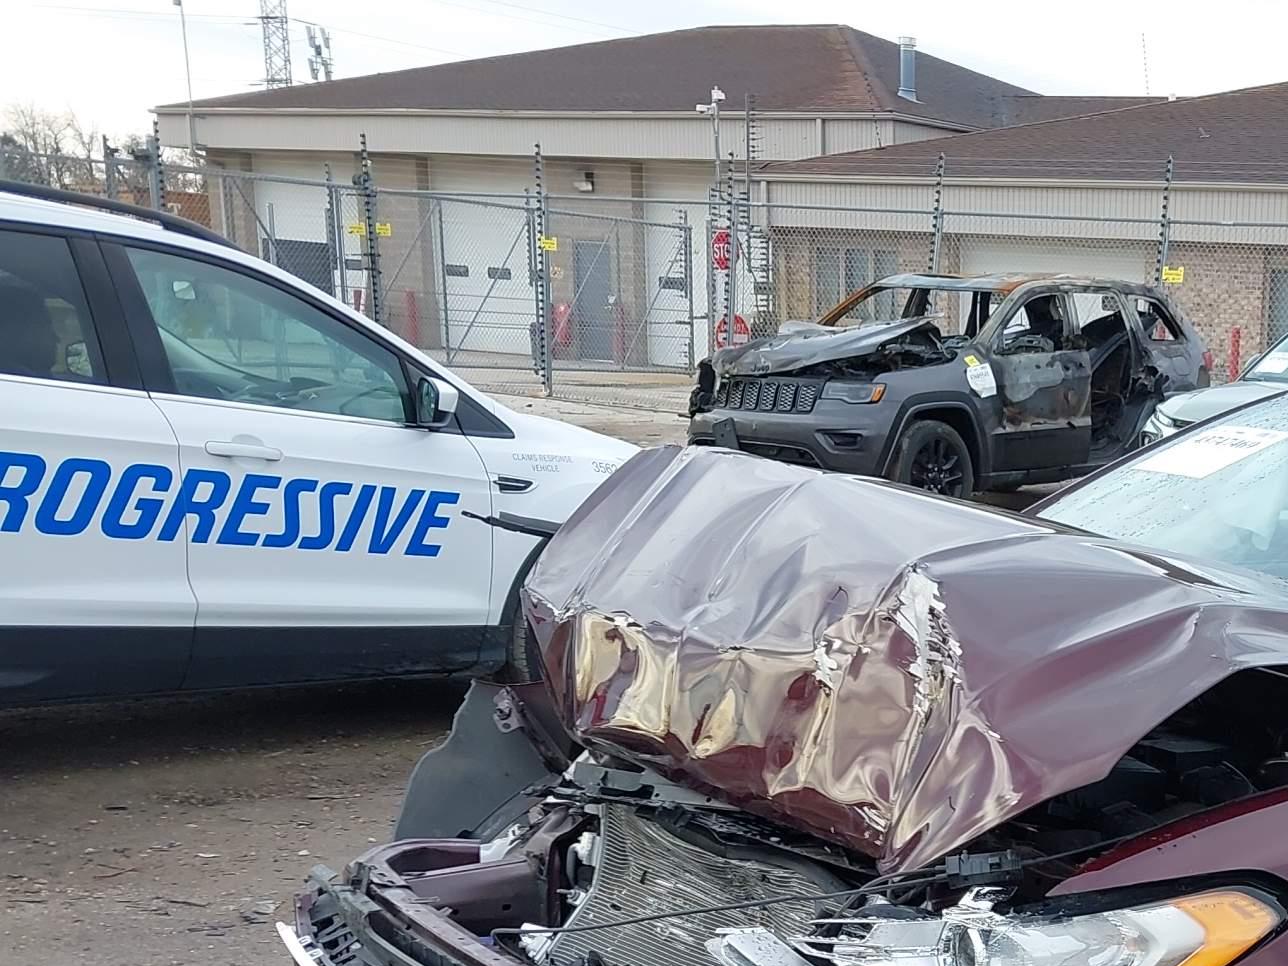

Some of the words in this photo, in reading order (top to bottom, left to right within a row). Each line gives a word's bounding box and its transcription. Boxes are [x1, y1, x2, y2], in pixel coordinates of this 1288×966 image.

[512, 453, 538, 462] CLAIMS
[539, 454, 575, 464] RESPONSE
[532, 464, 560, 473] VEHICLE
